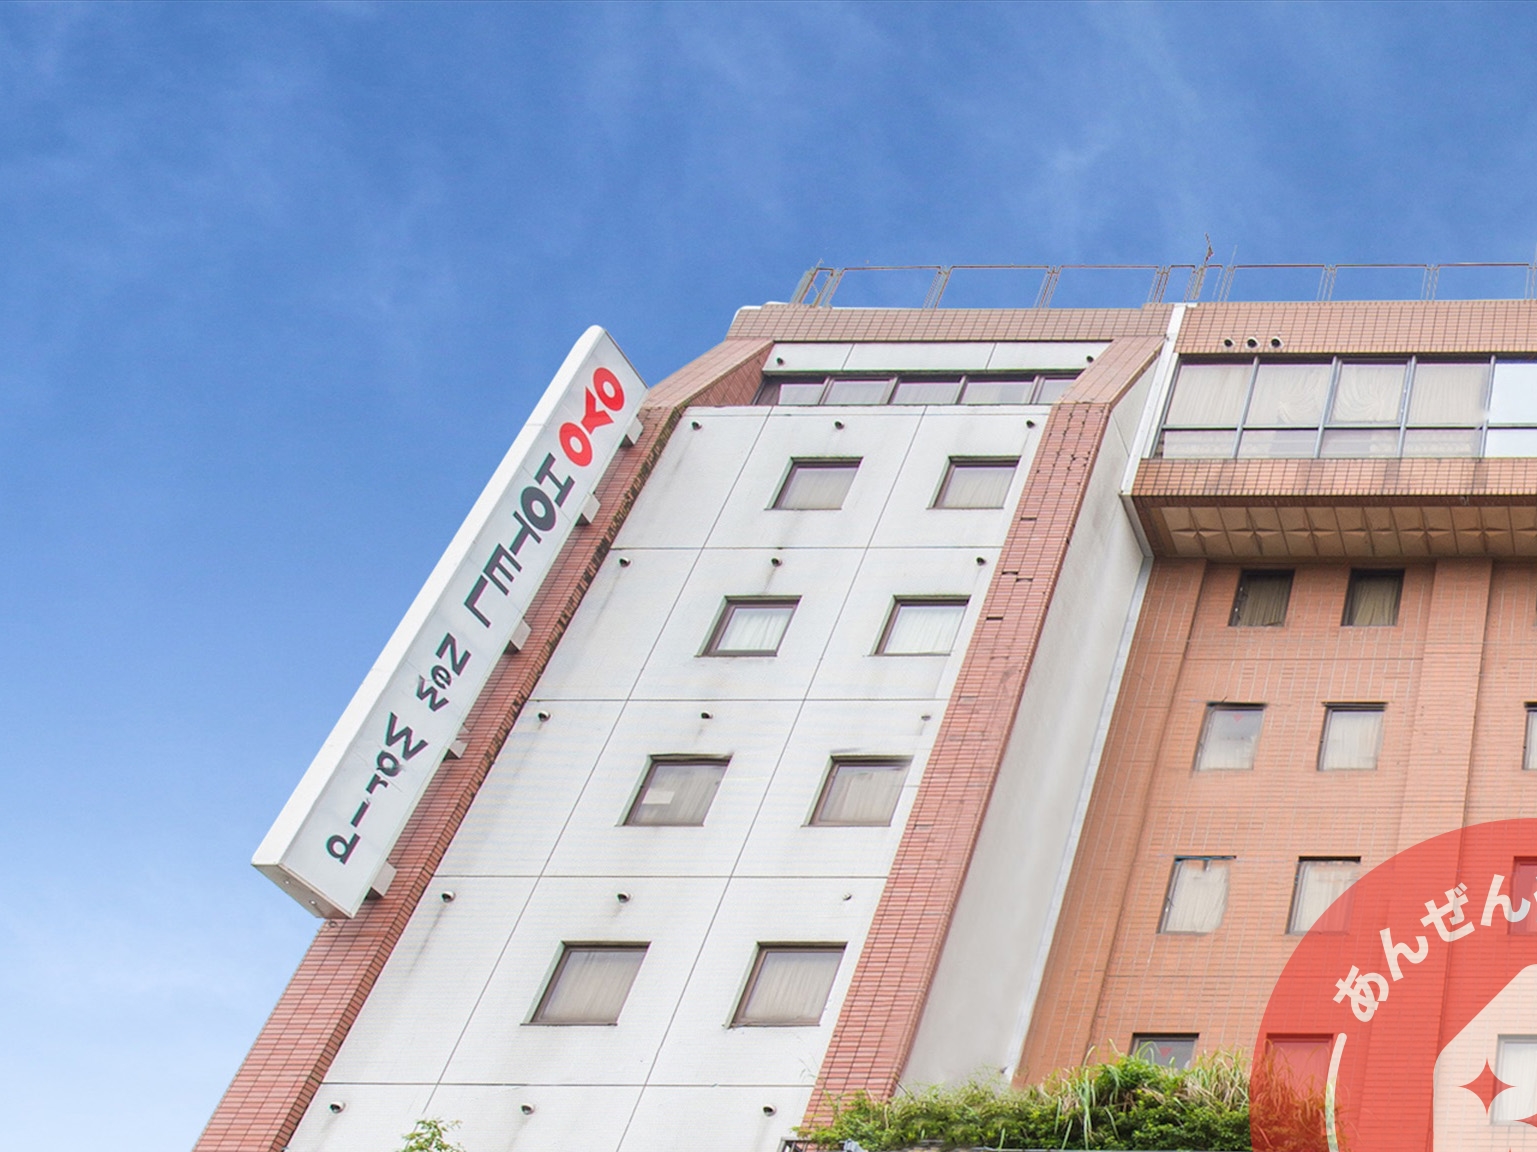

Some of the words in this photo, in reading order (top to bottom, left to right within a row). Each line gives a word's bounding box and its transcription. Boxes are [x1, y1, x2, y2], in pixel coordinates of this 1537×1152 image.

[559, 367, 625, 467] OYO
[464, 453, 575, 628] HOTEL
[416, 633, 472, 712] New
[326, 712, 428, 864] World
